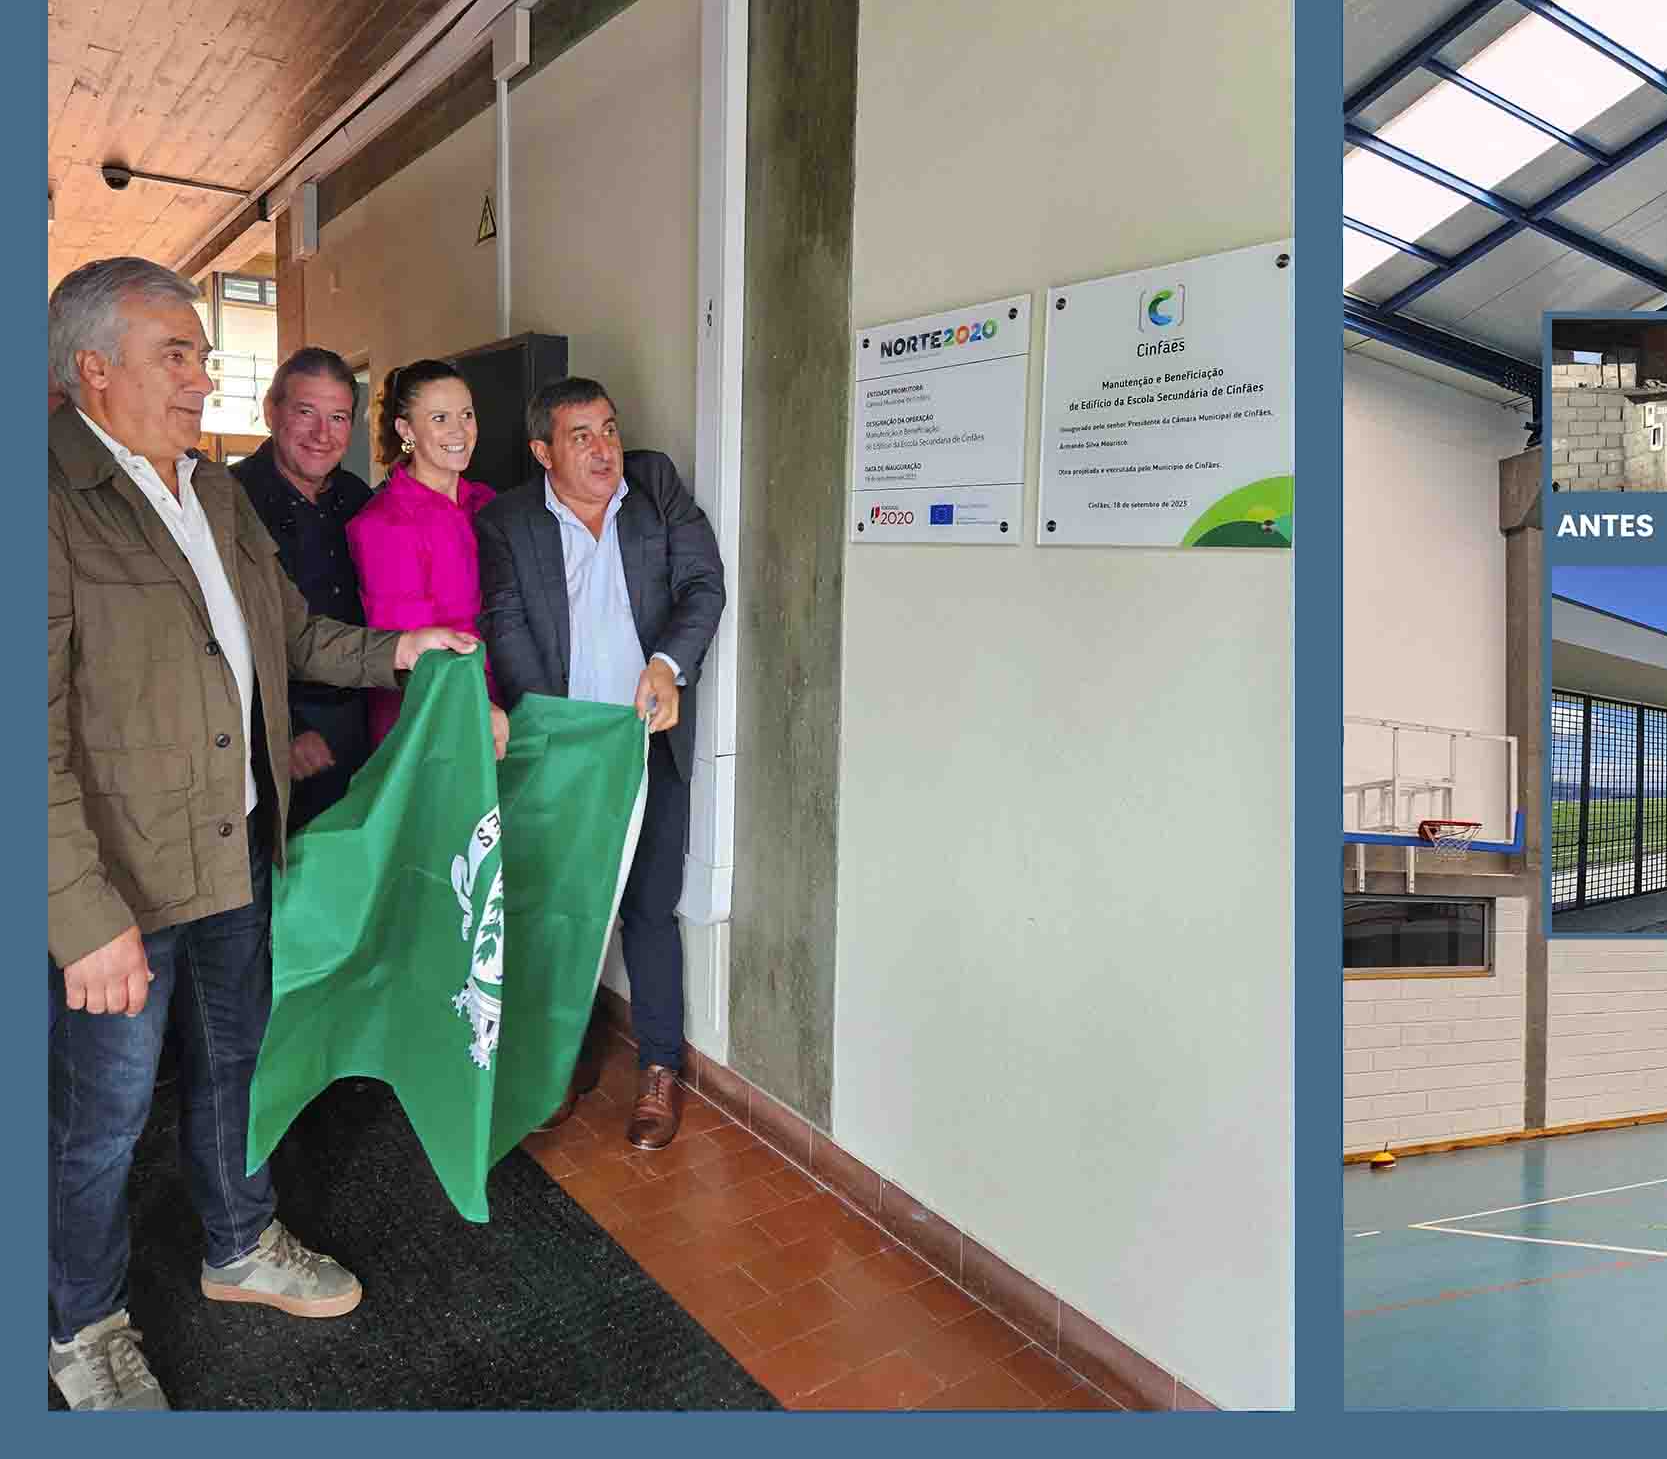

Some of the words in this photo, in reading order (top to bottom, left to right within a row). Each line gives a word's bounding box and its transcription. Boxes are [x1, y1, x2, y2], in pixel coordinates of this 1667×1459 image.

[880, 318, 998, 358] NORTE2020
[1137, 338, 1185, 358] Cinfães
[1102, 375, 1154, 390] Manutenção
[1156, 375, 1162, 384] e
[1164, 367, 1224, 384] Beneficiação
[1069, 402, 1079, 412] de
[1081, 397, 1111, 410] Edifício
[1114, 396, 1125, 407] da
[1127, 394, 1155, 406] Escola
[1157, 388, 1209, 403] Secundária
[1211, 386, 1223, 397] de
[1226, 382, 1264, 396] Cinfães
[1093, 423, 1105, 432] pelo
[1107, 421, 1127, 429] senhor
[1172, 415, 1197, 424] Câmara
[1199, 412, 1232, 422] Municipal
[1234, 411, 1242, 419] de
[1086, 440, 1100, 449] Silva
[1138, 465, 1151, 474] pelo
[1185, 462, 1194, 470] de
[1114, 501, 1121, 509] 18
[1122, 501, 1130, 509] de
[1131, 500, 1160, 509] setembro
[1161, 500, 1169, 508] de
[880, 511, 914, 525] 2020
